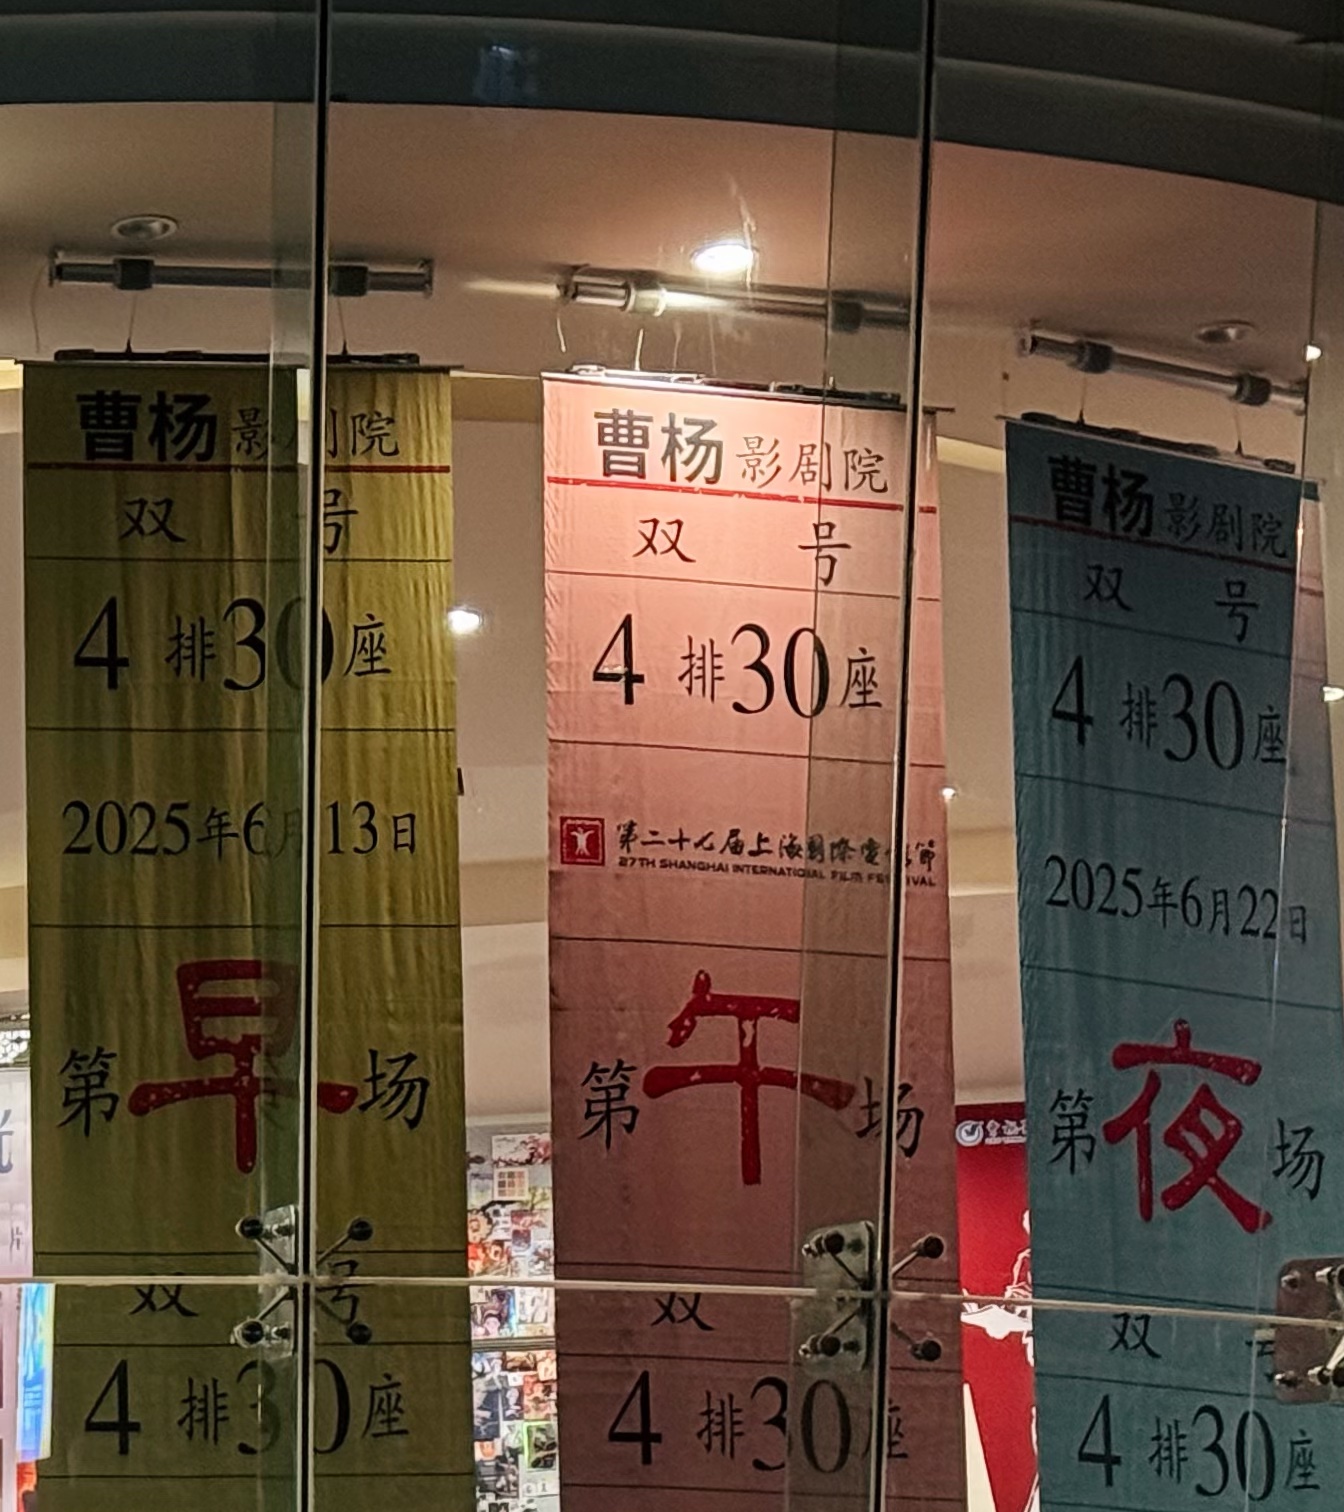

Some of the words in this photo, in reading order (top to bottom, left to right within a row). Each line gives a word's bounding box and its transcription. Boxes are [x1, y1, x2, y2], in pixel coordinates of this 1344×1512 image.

[76, 388, 400, 462] 曹杨影院
[593, 408, 889, 495] 曹杨影剧院
[1047, 455, 1288, 559] 曹杨影剧院
[592, 613, 883, 719] 4排30座
[1051, 655, 1288, 771] 4排30座
[618, 857, 657, 869] 27TH
[659, 858, 729, 874] SHANGHAI
[1044, 854, 1308, 945] 2025年6月22日
[1077, 1394, 1321, 1502] 4排30座
